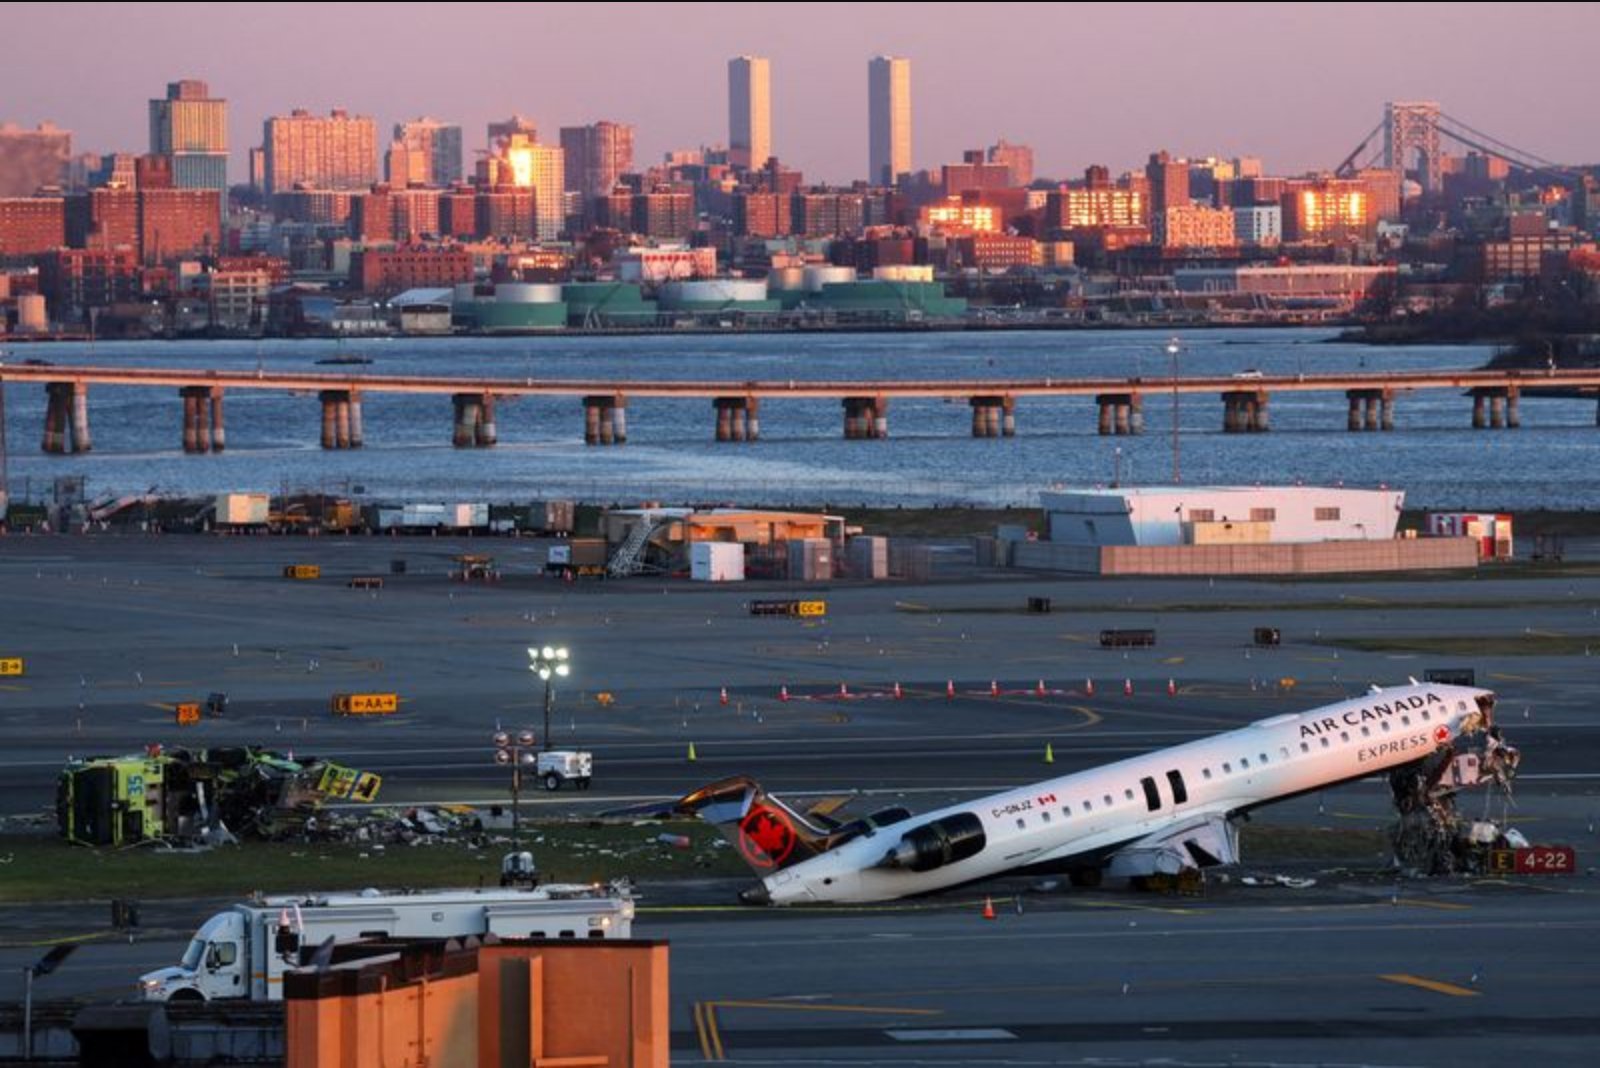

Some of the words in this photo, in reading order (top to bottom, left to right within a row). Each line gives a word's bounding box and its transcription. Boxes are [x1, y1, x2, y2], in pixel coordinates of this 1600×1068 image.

[365, 697, 383, 709] AA
[1300, 718, 1339, 738] AIR
[1343, 692, 1442, 726] CANADA
[1357, 733, 1428, 762] EXPRESS
[128, 773, 144, 796] 35
[1497, 852, 1506, 869] E
[1524, 852, 1567, 868] 4-22
